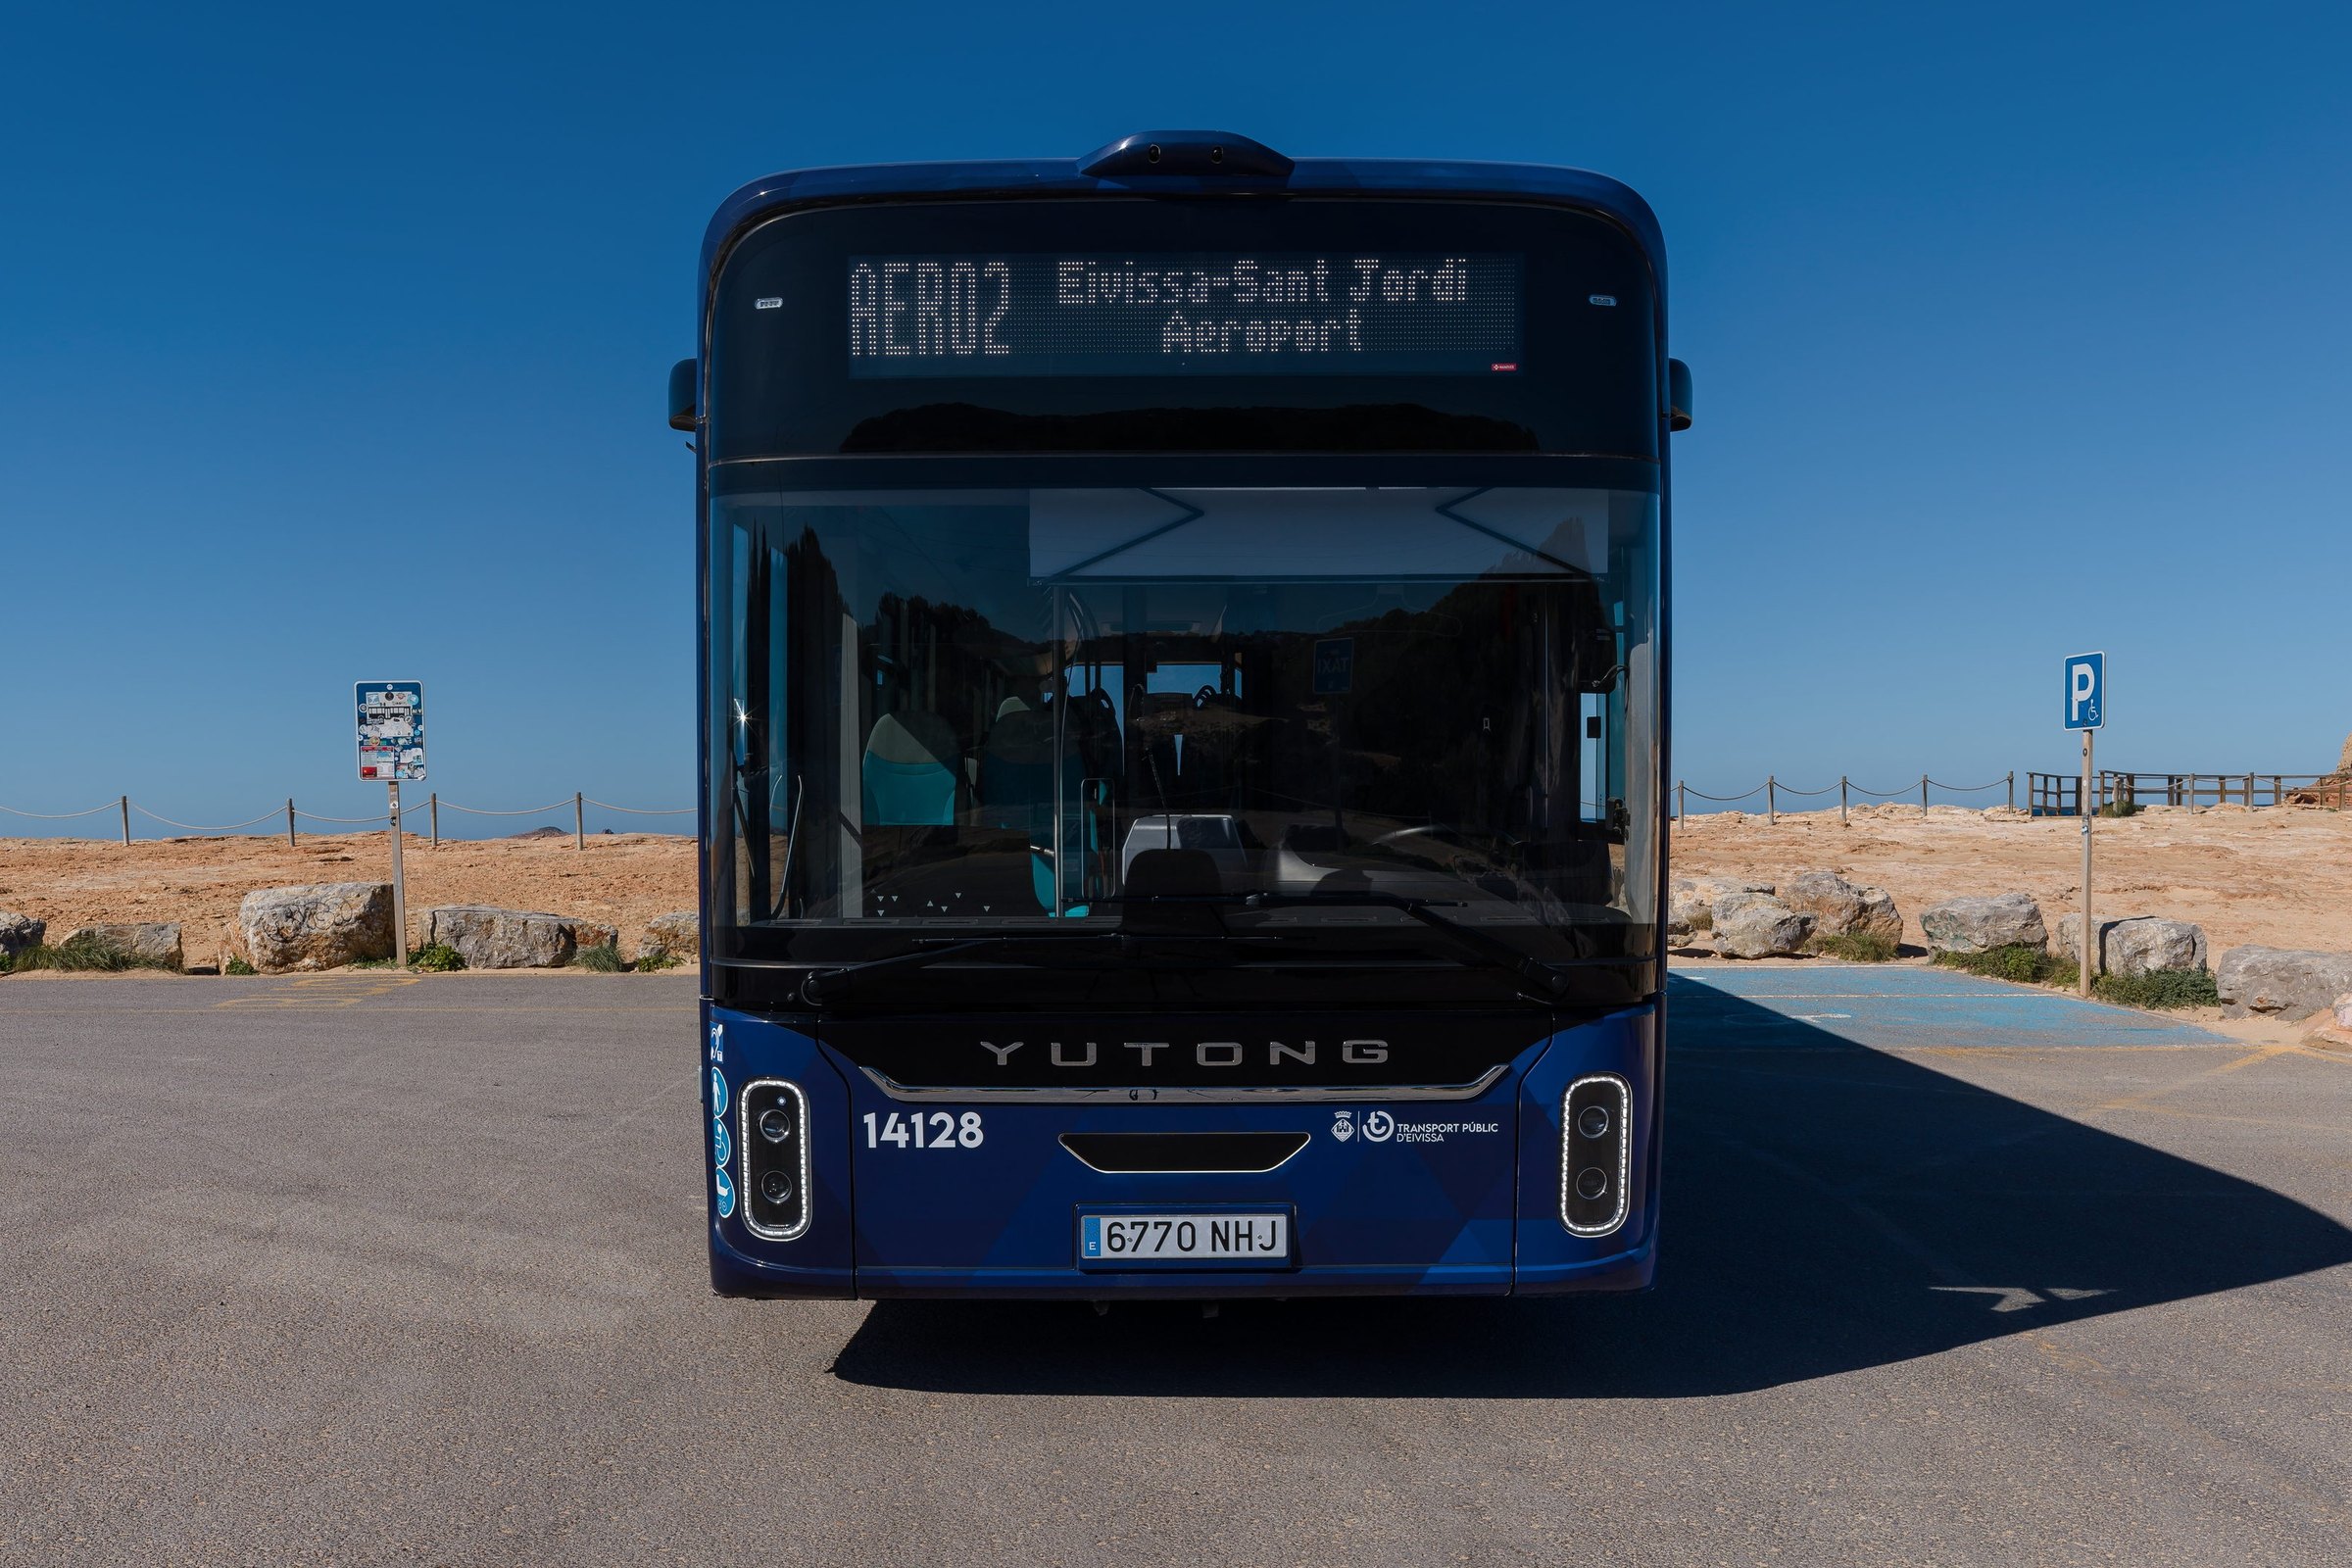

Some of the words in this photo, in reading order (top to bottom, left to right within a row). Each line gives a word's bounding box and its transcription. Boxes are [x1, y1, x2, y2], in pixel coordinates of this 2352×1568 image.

[1058, 259, 1330, 304] Eivissa-Sant
[1348, 258, 1468, 303] Jordi
[850, 261, 1010, 356] AERO2
[1161, 309, 1362, 354] Aeroport
[2072, 662, 2095, 721] P
[980, 1039, 1389, 1067] YUTONG
[863, 1111, 984, 1149] 14128
[1396, 1123, 1460, 1133] TRANSPORT
[1462, 1121, 1498, 1133] PÚBLIC
[1396, 1133, 1445, 1143] D'EIVISSA
[1089, 1241, 1097, 1250] E
[1106, 1220, 1197, 1252] 6770
[1210, 1220, 1276, 1251] NHJ
